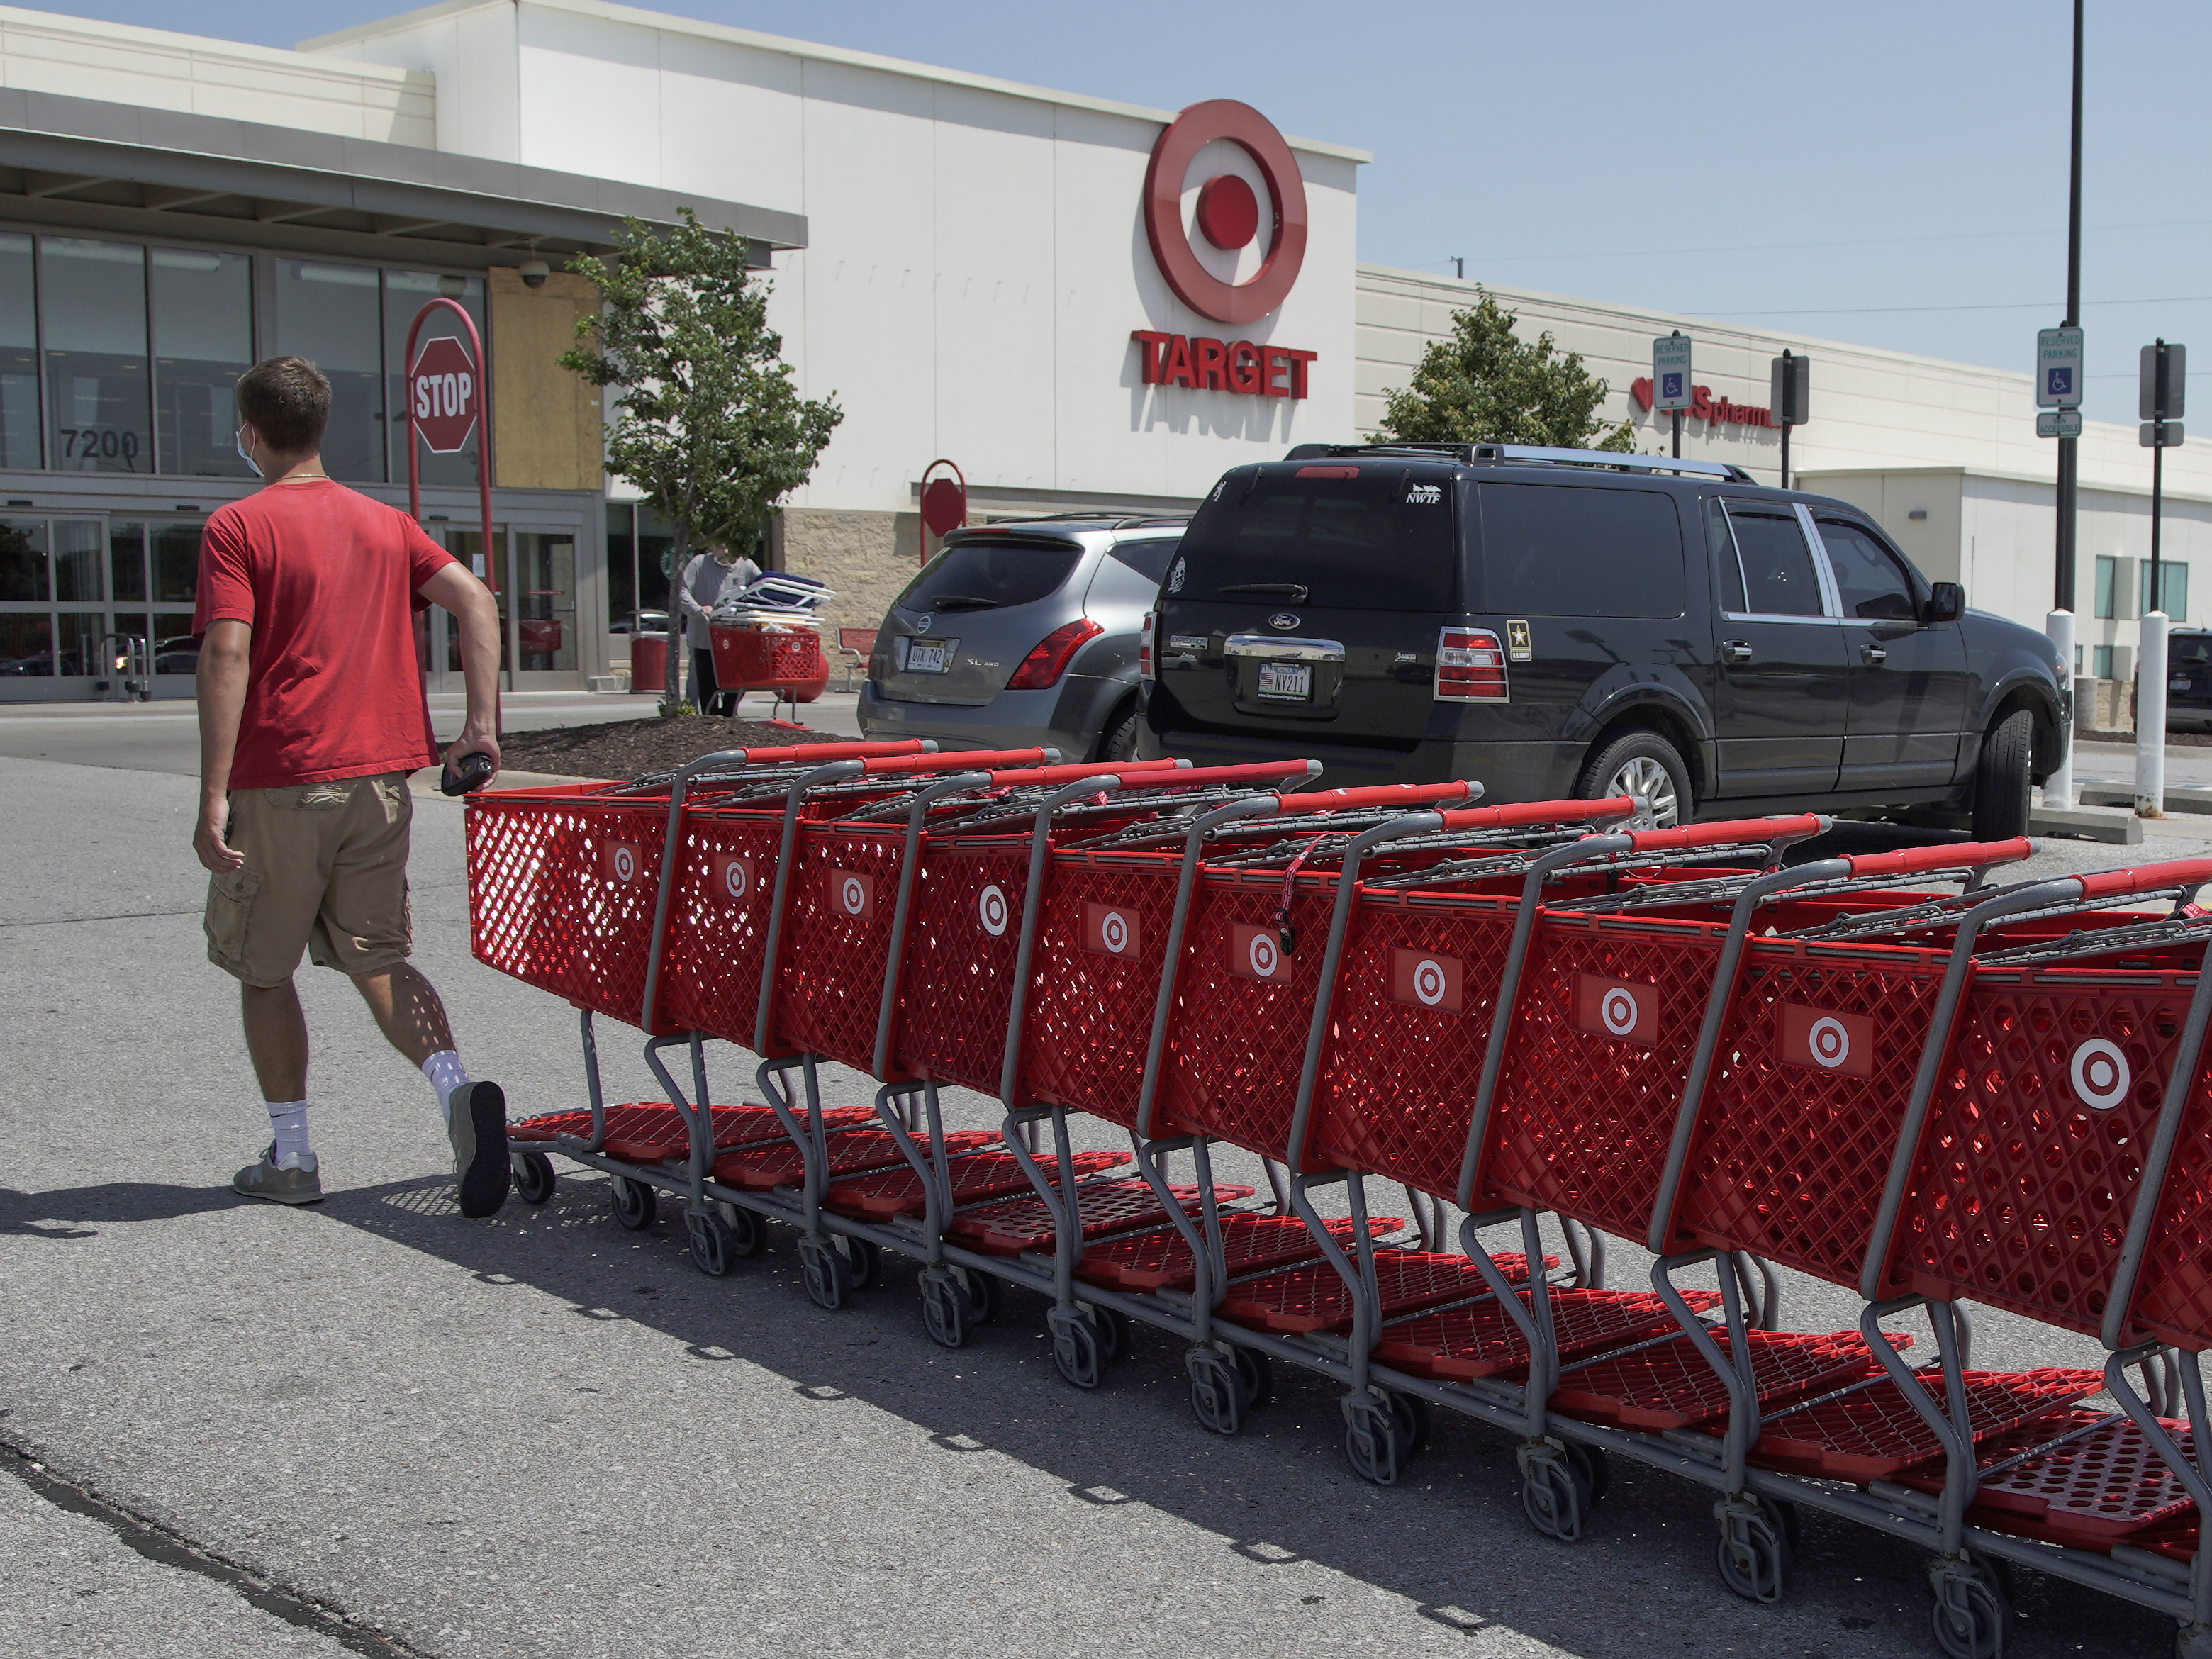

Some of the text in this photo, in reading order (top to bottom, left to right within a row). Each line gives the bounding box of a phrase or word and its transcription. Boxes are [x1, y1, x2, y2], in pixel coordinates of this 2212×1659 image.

[2040, 335, 2080, 346] RESERVED
[1655, 343, 1689, 353] RESERVED
[2043, 348, 2078, 359] PARKING
[1131, 330, 1317, 399] TARGET
[1658, 355, 1687, 365] PARKING
[416, 372, 471, 419] STOP
[2040, 424, 2079, 433] ACCESSIBLE
[60, 430, 138, 458] 7200
[1406, 493, 1441, 503] NWTF
[1275, 674, 1304, 693] NY211
